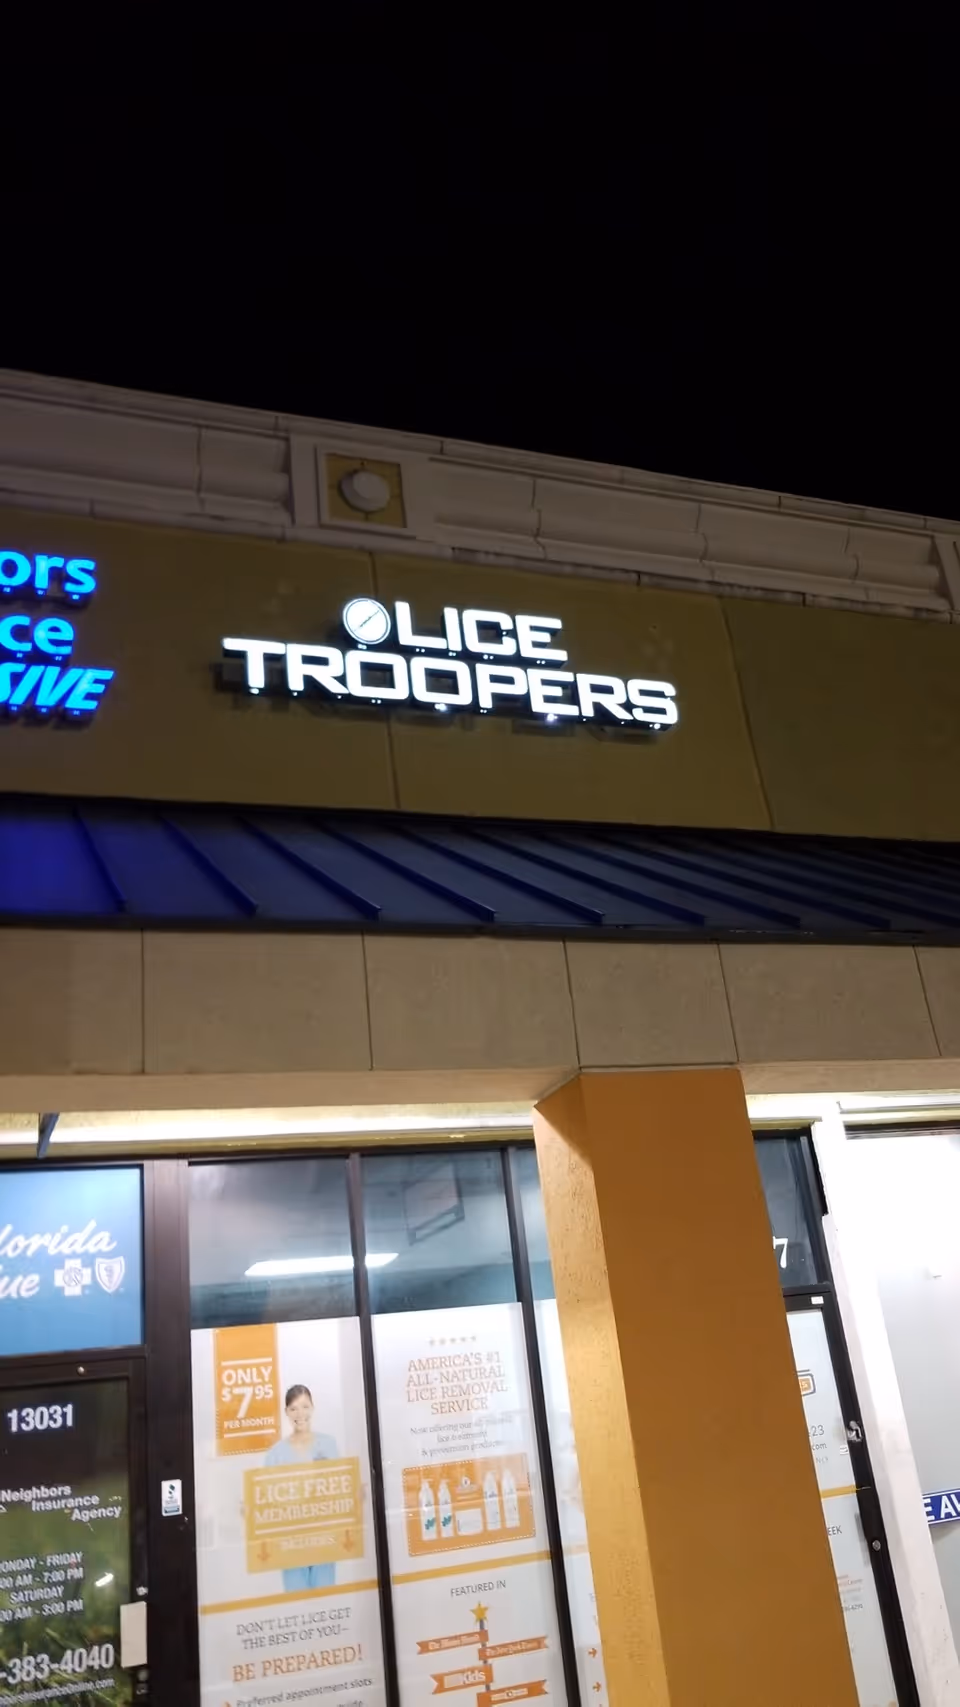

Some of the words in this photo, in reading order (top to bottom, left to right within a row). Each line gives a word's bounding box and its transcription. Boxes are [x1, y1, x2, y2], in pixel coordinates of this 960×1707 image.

[0, 551, 97, 594] ors
[0, 615, 75, 655] ce
[395, 601, 568, 662] LICE
[222, 637, 678, 724] TROOPERS
[0, 1264, 40, 1298] ue
[408, 1352, 483, 1372] AMERICA'S
[486, 1351, 502, 1363] #1
[222, 1366, 273, 1386] ONLY
[407, 1365, 505, 1387] ALL-NATURAL
[407, 1386, 437, 1403] LICE
[442, 1379, 508, 1400] REMOVAL
[431, 1397, 488, 1415] SERVICE
[7, 1403, 74, 1433] 13031
[224, 1420, 240, 1429] PER
[241, 1416, 274, 1427] MONTH
[809, 1424, 825, 1438] 23
[0, 1485, 72, 1502] Neighbors
[255, 1482, 299, 1505] LICE
[304, 1475, 352, 1499] FREE
[32, 1495, 100, 1511] Insurance
[255, 1498, 354, 1523] MEMBERSHIP
[71, 1506, 122, 1522] Agency
[46, 1551, 83, 1567] FRIDAY
[15, 1574, 33, 1587] AM
[67, 1567, 83, 1580] PM
[10, 1585, 64, 1604] SATURDAY
[450, 1582, 495, 1598] FEATURED
[496, 1579, 507, 1590] IN
[14, 1606, 33, 1619] AM
[66, 1599, 83, 1612] PM
[236, 1619, 276, 1636] DON'T
[277, 1615, 299, 1628] LET
[301, 1612, 327, 1626] LICE
[329, 1607, 351, 1620] GET
[241, 1635, 267, 1650] THE
[268, 1631, 297, 1647] BEST
[299, 1628, 314, 1641] OF
[233, 1662, 256, 1682] BE
[261, 1643, 363, 1677] PREPARED!
[350, 1677, 373, 1689] slots
